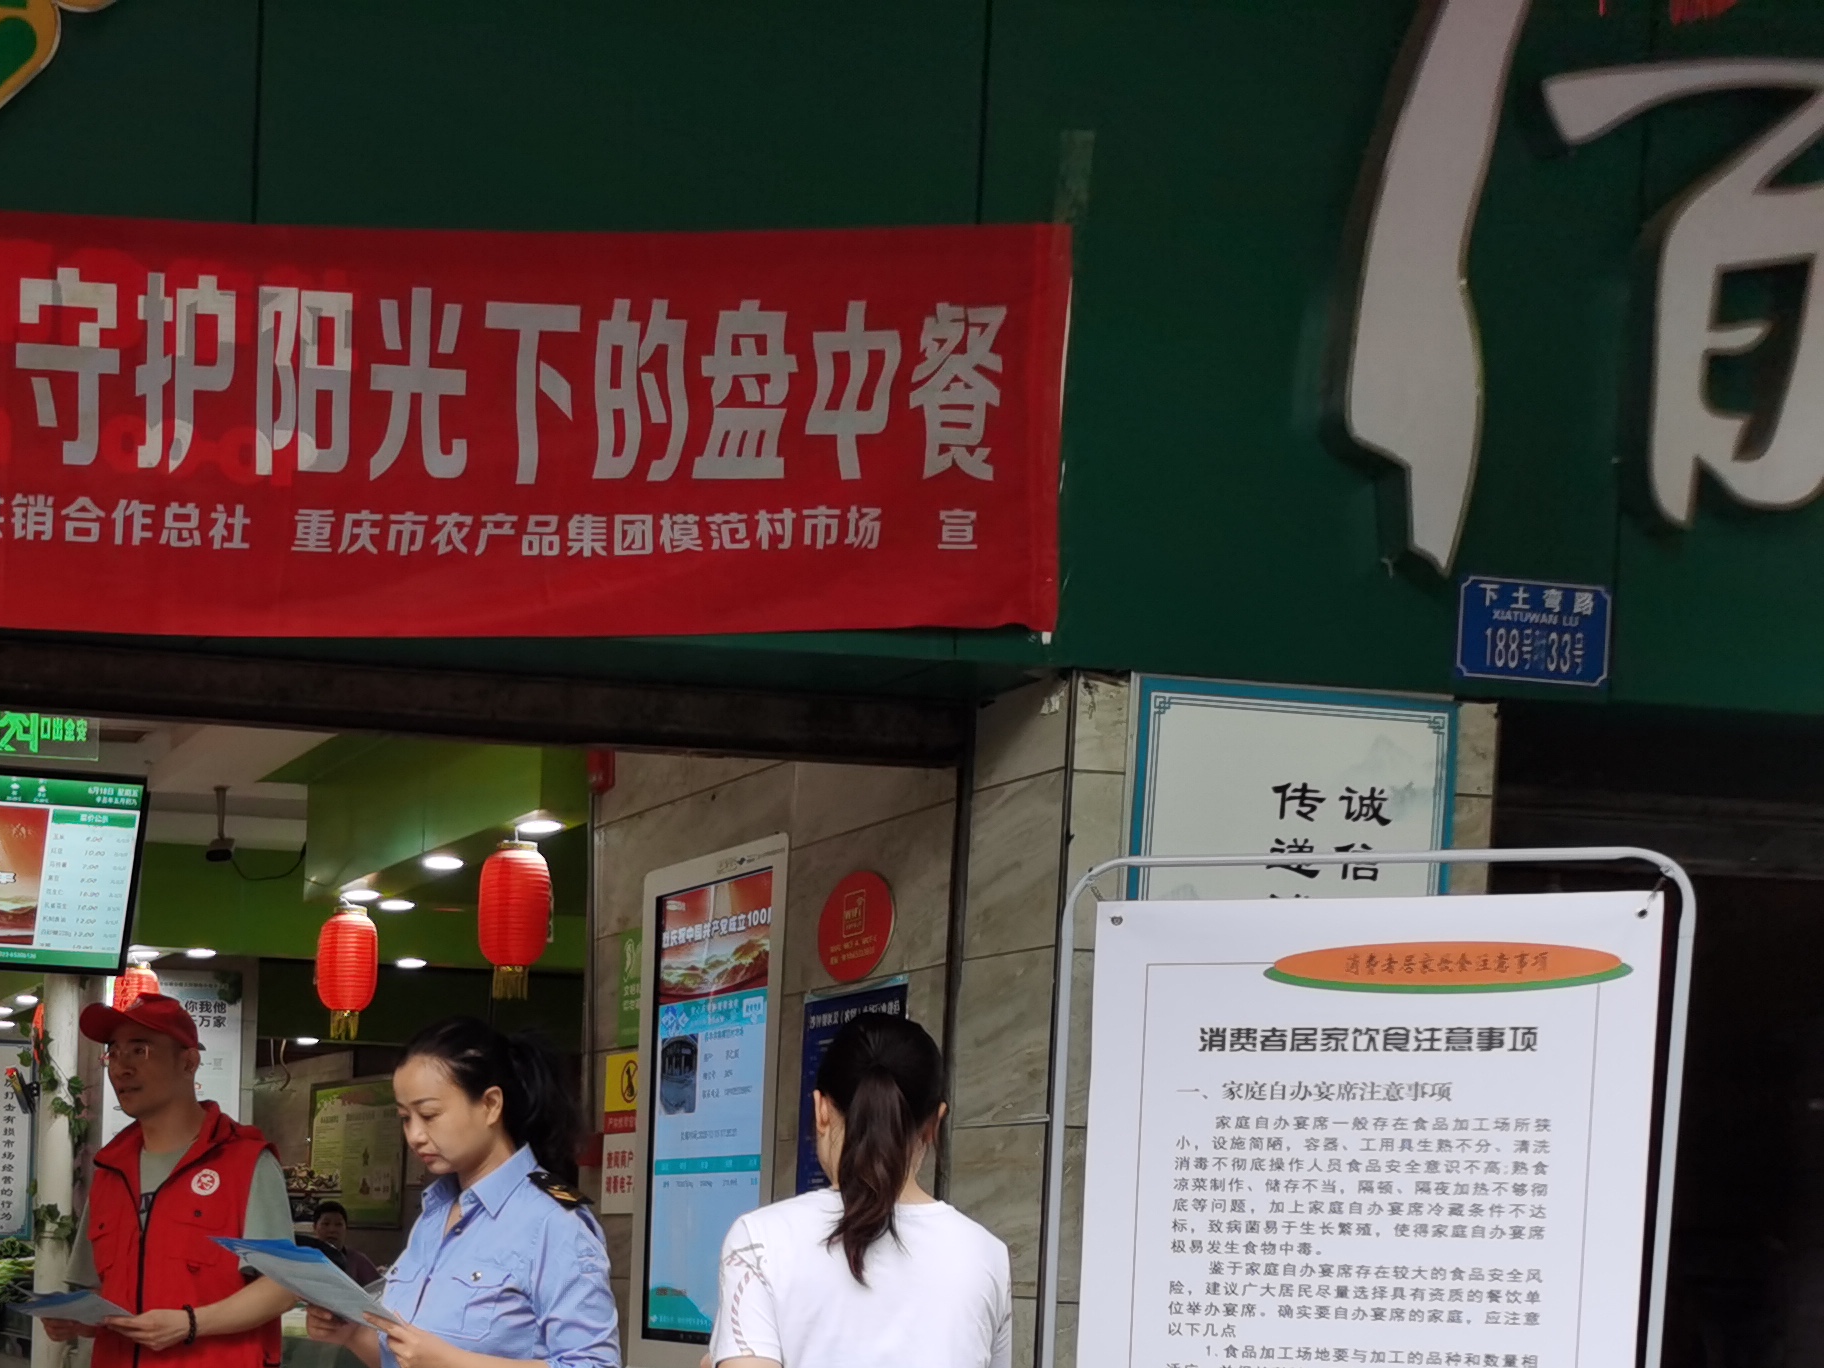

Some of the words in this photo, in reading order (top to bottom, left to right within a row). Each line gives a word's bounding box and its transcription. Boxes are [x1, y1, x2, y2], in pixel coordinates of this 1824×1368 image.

[290, 505, 883, 560] 重庆市农产品集团模范村市场
[936, 508, 981, 553] 宣
[1478, 583, 1596, 616] 下土弯路
[1491, 608, 1559, 626] XIATUWAN
[1562, 614, 1580, 628] LU
[1199, 1026, 1539, 1054] 消费者居家饮食注意事项
[1176, 1080, 1453, 1104] 一、家庭自办宴席注意事项
[1169, 1239, 1324, 1260] 极易发生食物中毒。
[1167, 1321, 1237, 1339] 以下几点
